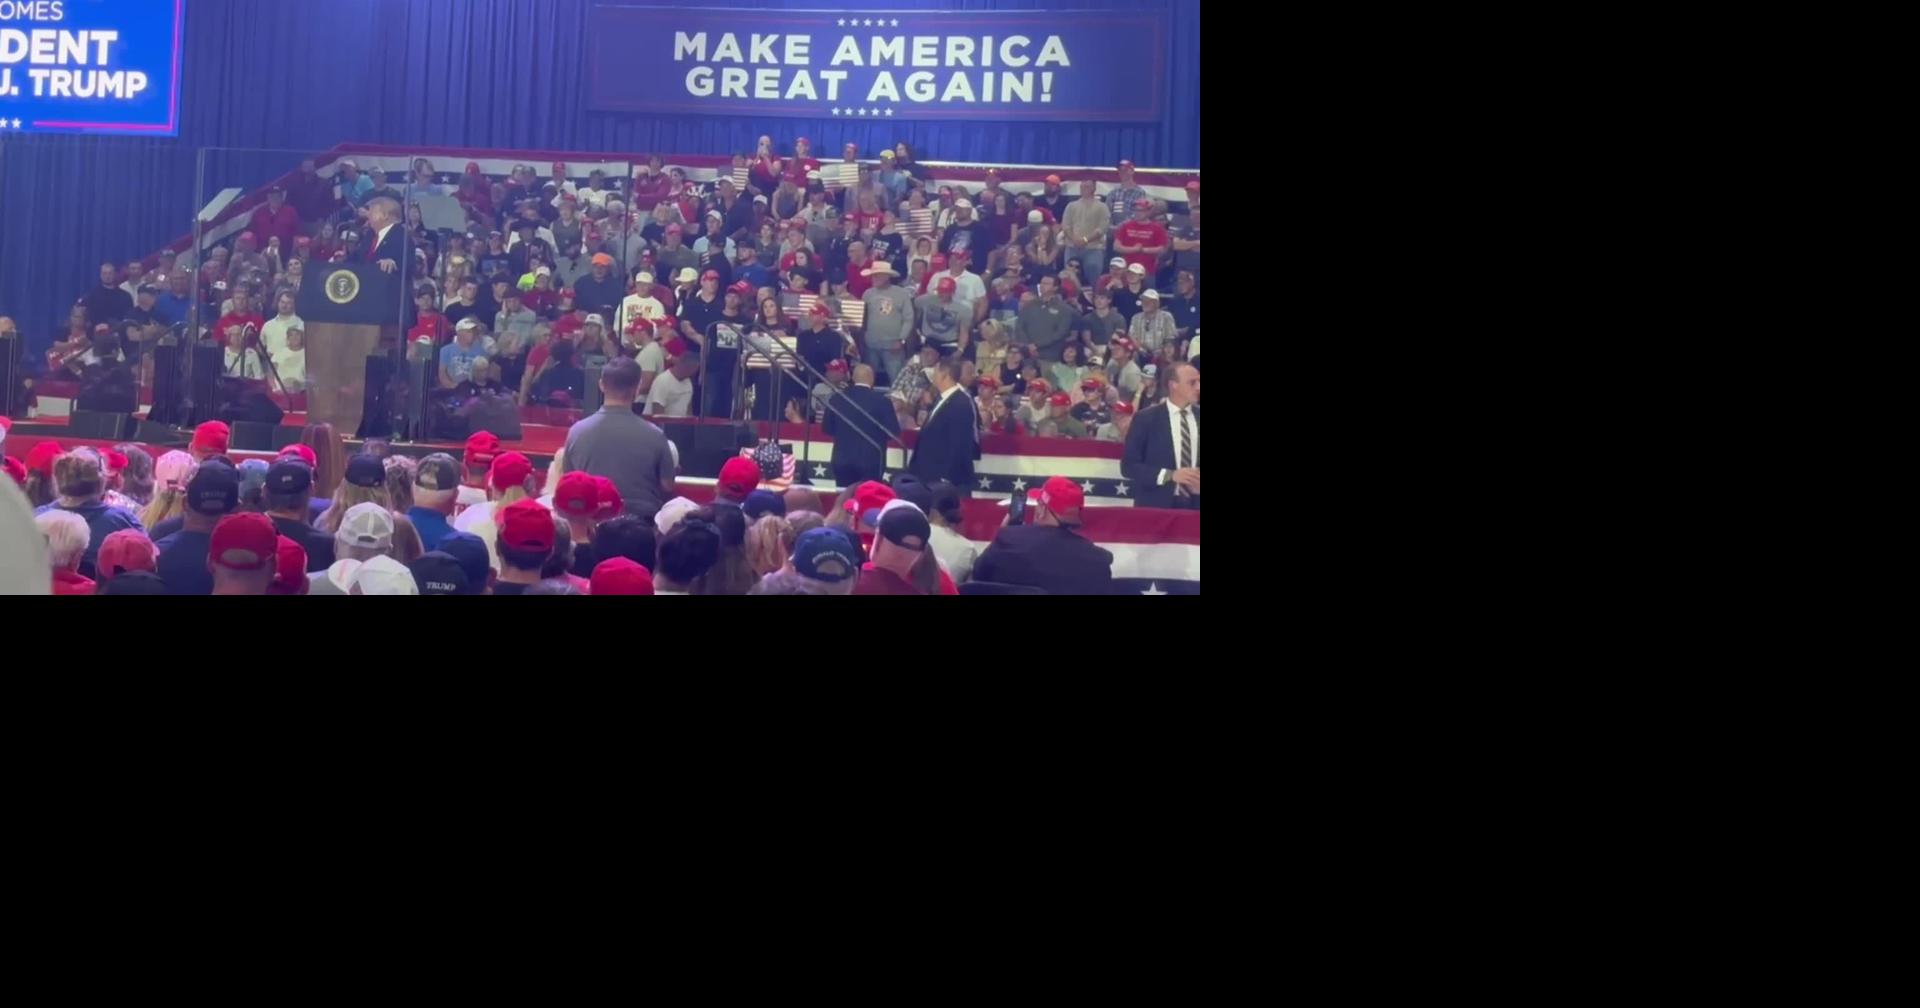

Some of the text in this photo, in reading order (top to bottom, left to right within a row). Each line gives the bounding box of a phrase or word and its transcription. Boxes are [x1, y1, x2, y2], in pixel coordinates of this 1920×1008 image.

[0, 1, 63, 20] OMES
[0, 29, 118, 65] DENT
[674, 31, 1070, 67] MAKE AMERICA
[29, 70, 147, 98] TRUMP
[685, 66, 1052, 102] GREAT AGAIN!
[425, 581, 457, 591] TRUMP
